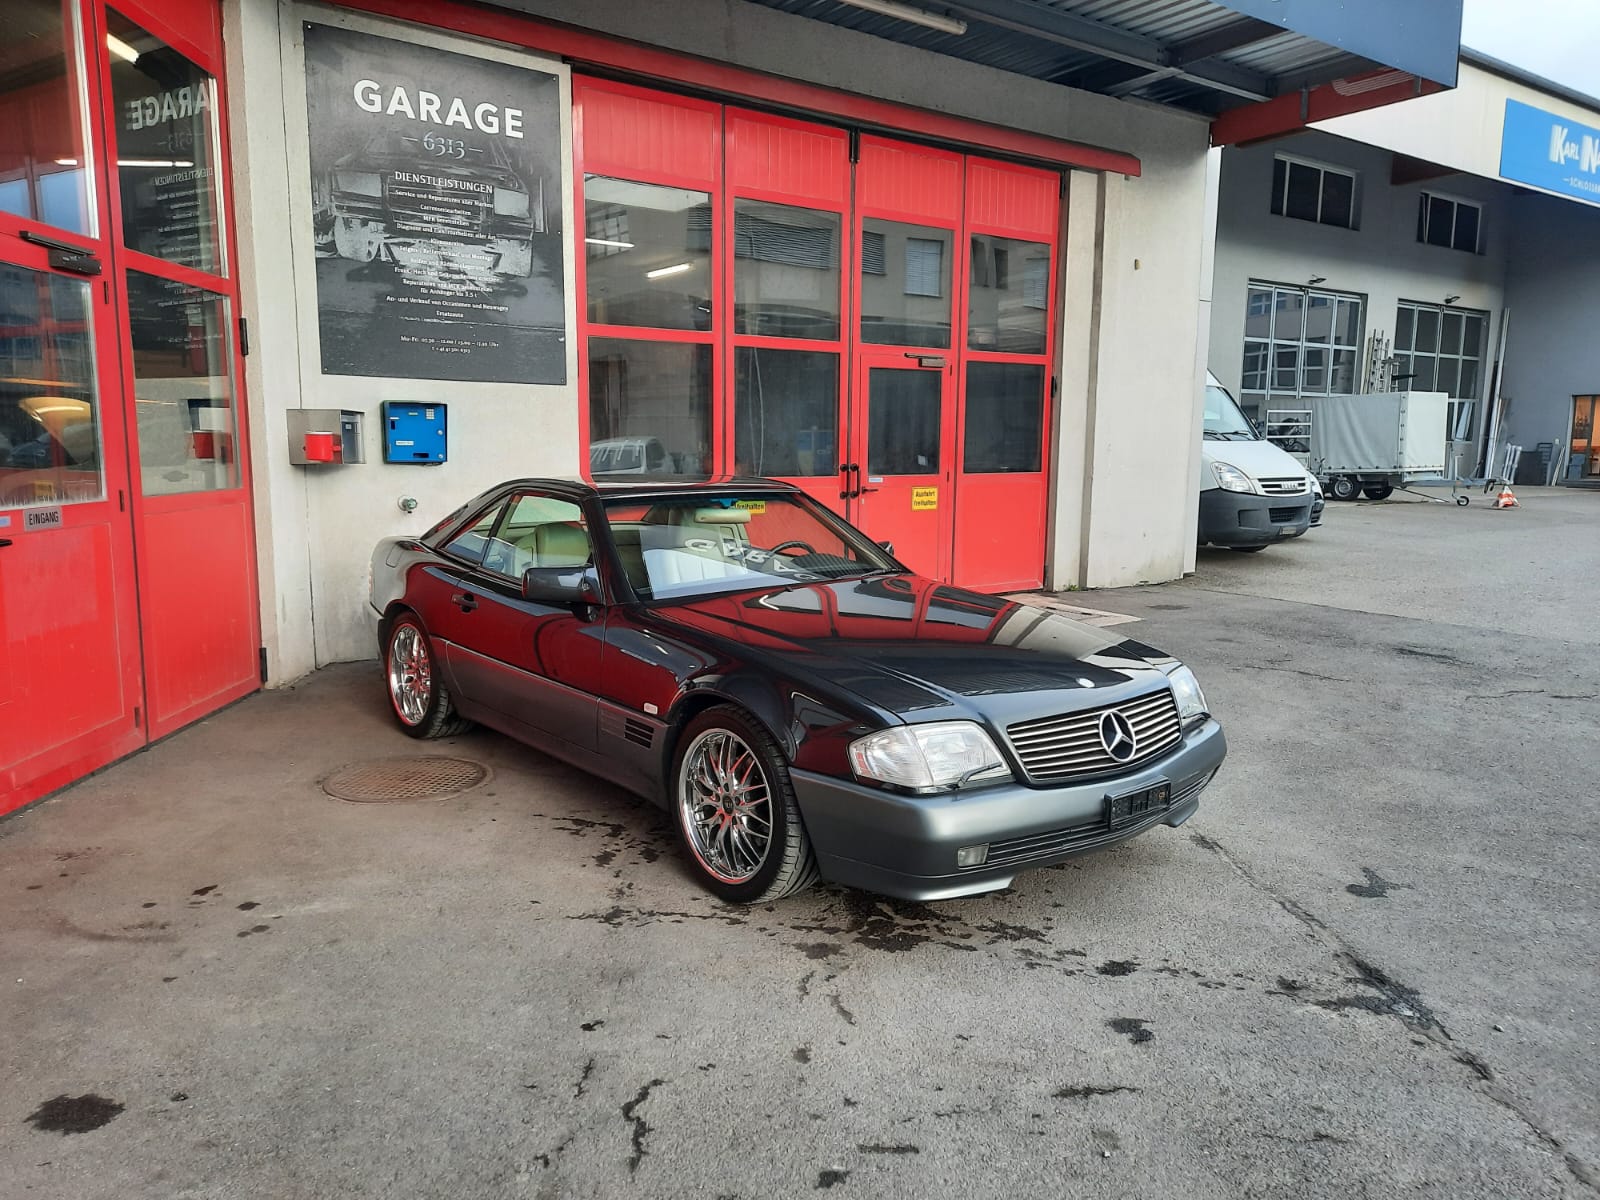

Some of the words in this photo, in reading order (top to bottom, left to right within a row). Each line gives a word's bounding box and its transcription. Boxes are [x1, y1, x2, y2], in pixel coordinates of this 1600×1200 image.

[352, 77, 523, 139] GARAGE
[423, 131, 465, 159] 6313
[394, 170, 493, 194] DIENSTLEISTUNGEN
[416, 192, 427, 200] und
[422, 225, 433, 233] und
[409, 297, 430, 305] Verkauf
[28, 511, 59, 525] EINGANG
